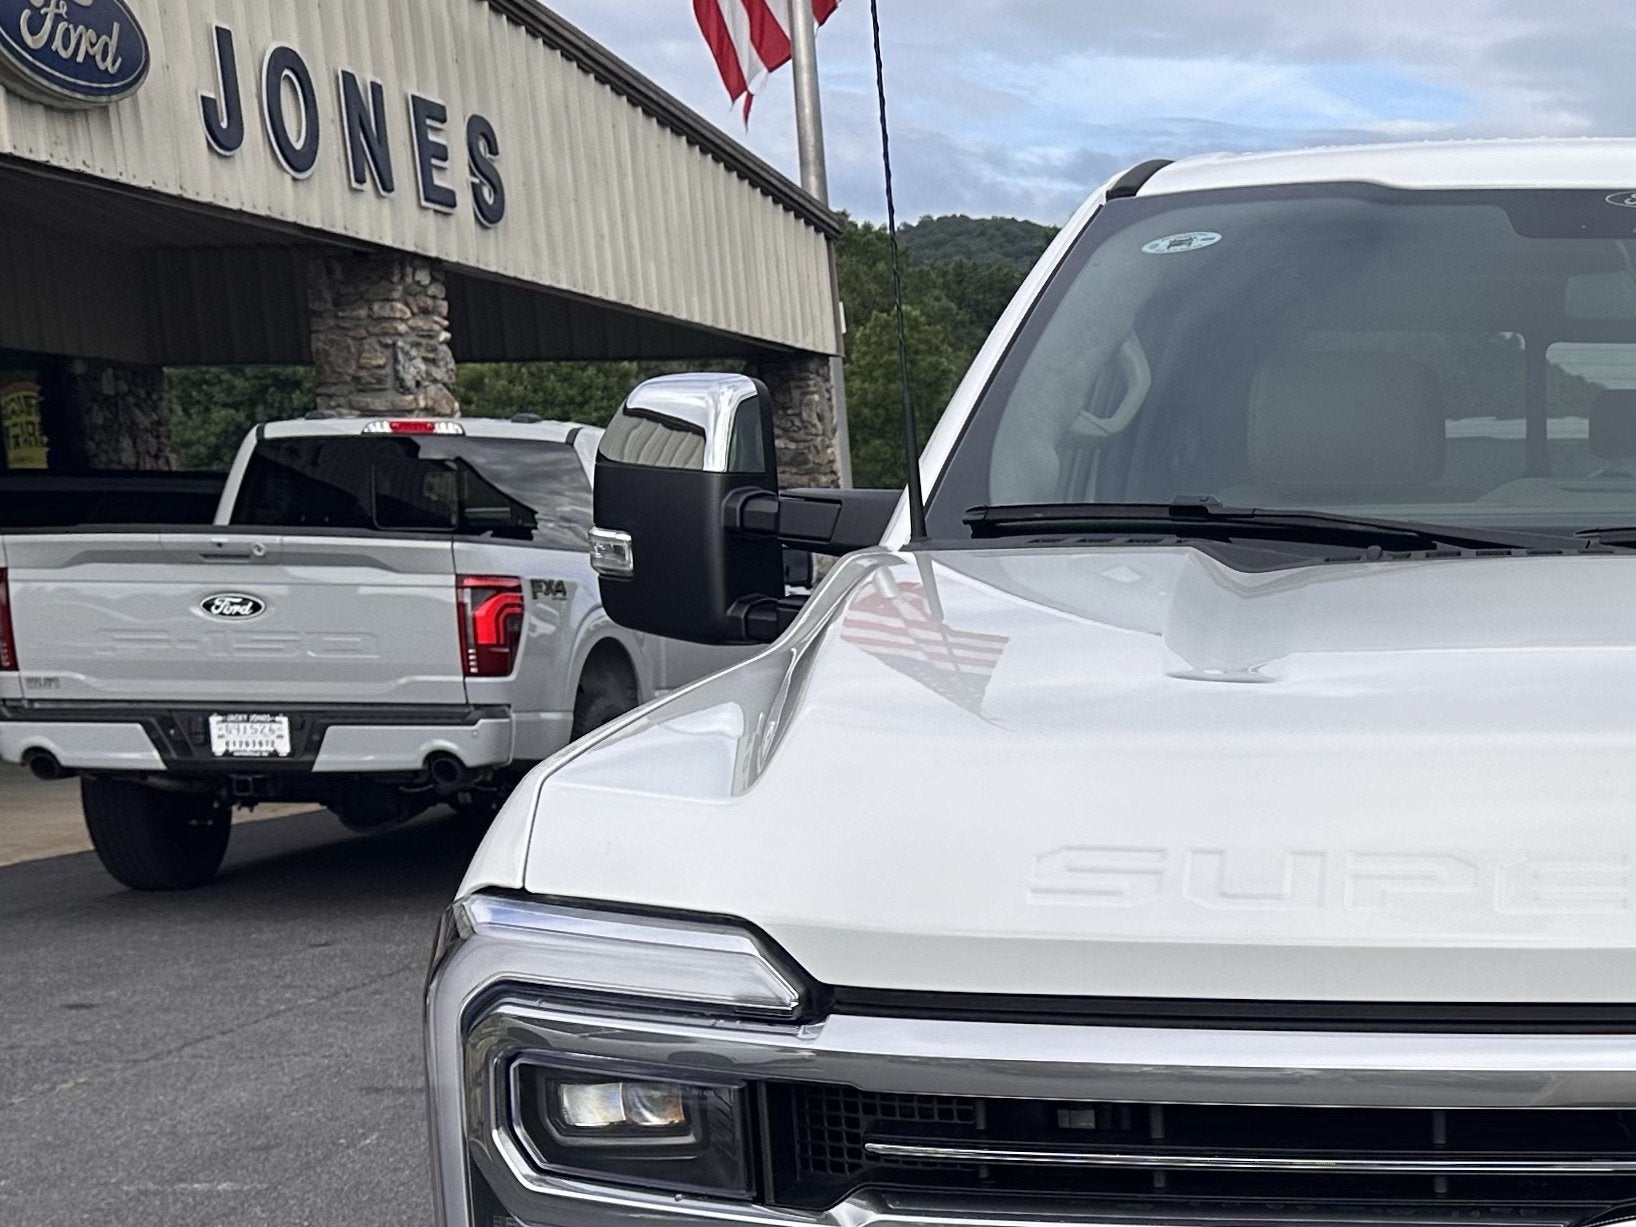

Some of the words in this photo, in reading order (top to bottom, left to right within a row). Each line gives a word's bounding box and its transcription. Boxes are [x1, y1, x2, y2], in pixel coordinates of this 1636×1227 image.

[20, 0, 122, 74] Ford
[198, 25, 506, 229] JONES
[210, 597, 253, 616] Ford
